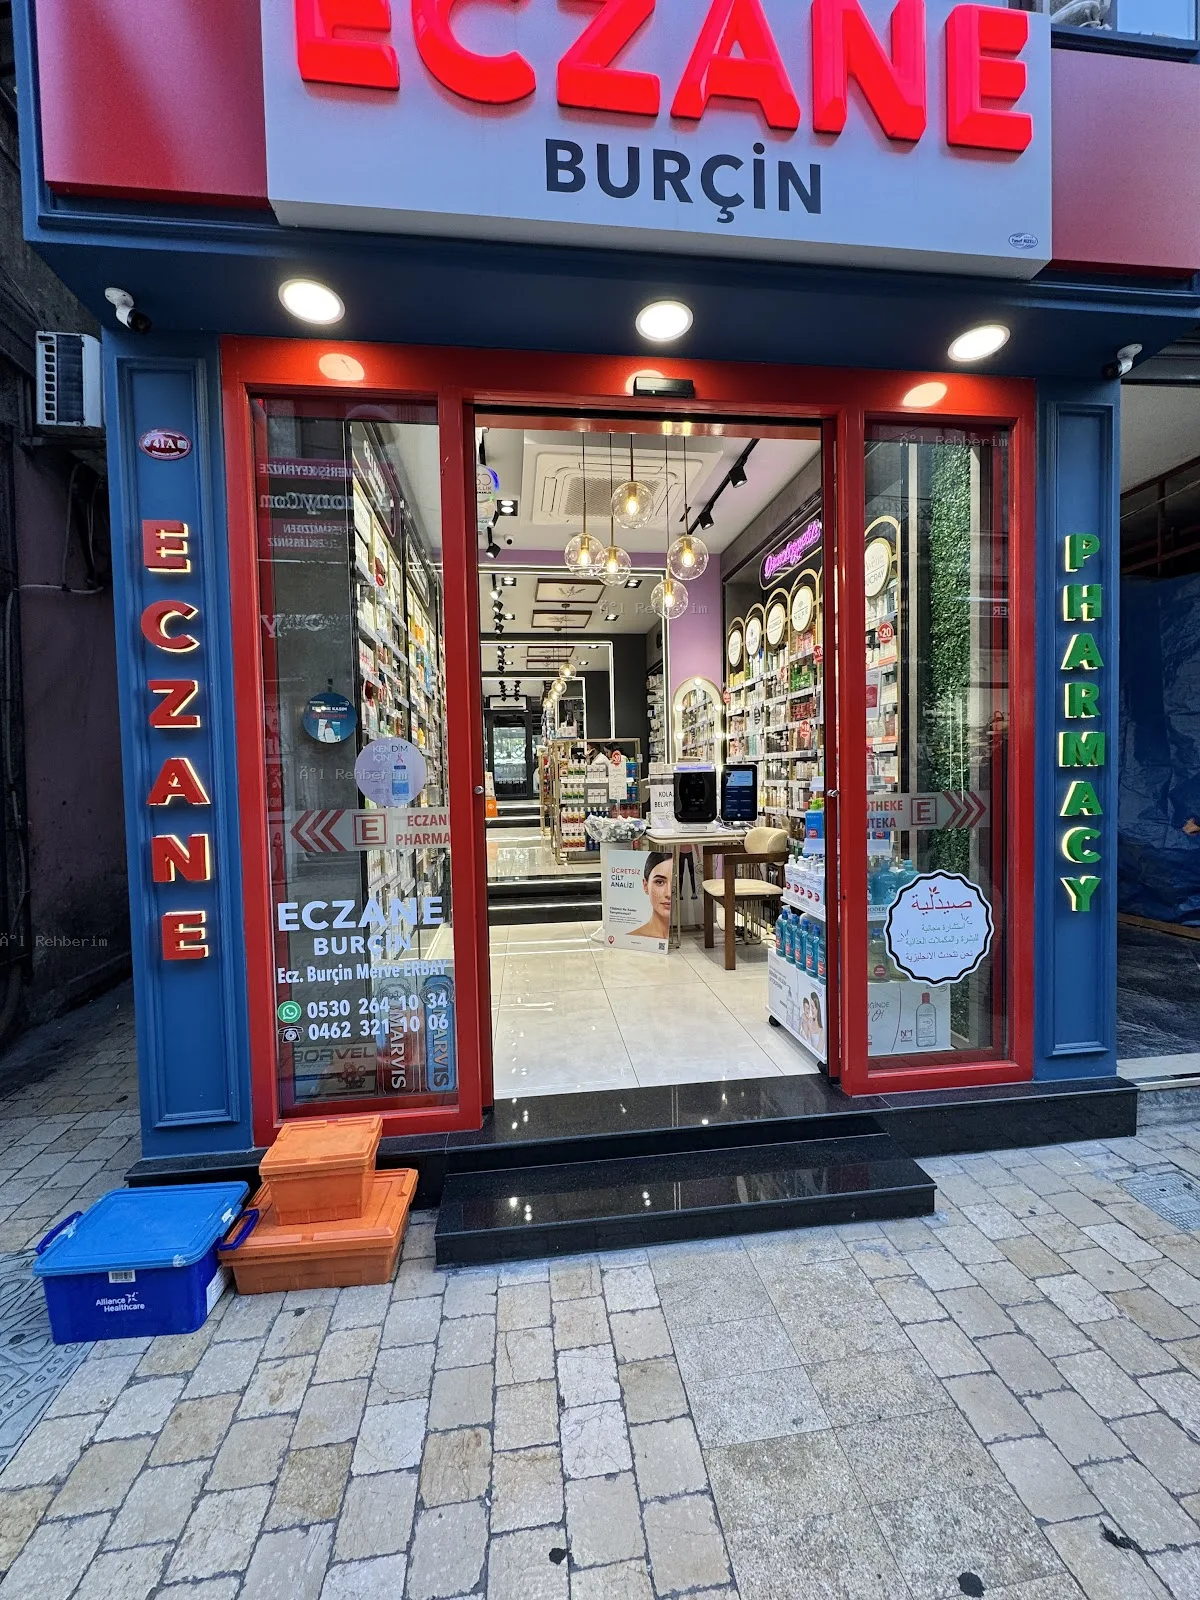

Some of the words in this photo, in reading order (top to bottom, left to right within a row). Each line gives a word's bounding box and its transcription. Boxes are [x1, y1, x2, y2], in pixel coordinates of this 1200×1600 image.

[294, 0, 1034, 154] ECZANE
[545, 138, 822, 223] BURÇİN
[1058, 532, 1106, 912] PHARMACY
[141, 519, 211, 961] ECZANE
[407, 815, 450, 827] ECZAN
[277, 896, 443, 932] ECZANE
[911, 894, 973, 916] صيدلية
[313, 929, 412, 956] BURÇİN
[277, 967, 304, 984] Ecz.
[307, 964, 352, 985] Burçin
[356, 963, 400, 980] Merve
[404, 960, 447, 977] ERBAY
[307, 1000, 351, 1019] 0530
[358, 996, 390, 1015] 264
[398, 994, 419, 1011] 10
[427, 992, 448, 1009] 34
[308, 1021, 352, 1040] 0462
[359, 1018, 390, 1037] 321
[399, 1016, 420, 1033] 10
[428, 1013, 449, 1030] 06
[96, 1297, 126, 1306] Alliance
[103, 1303, 146, 1313] Healthcare
